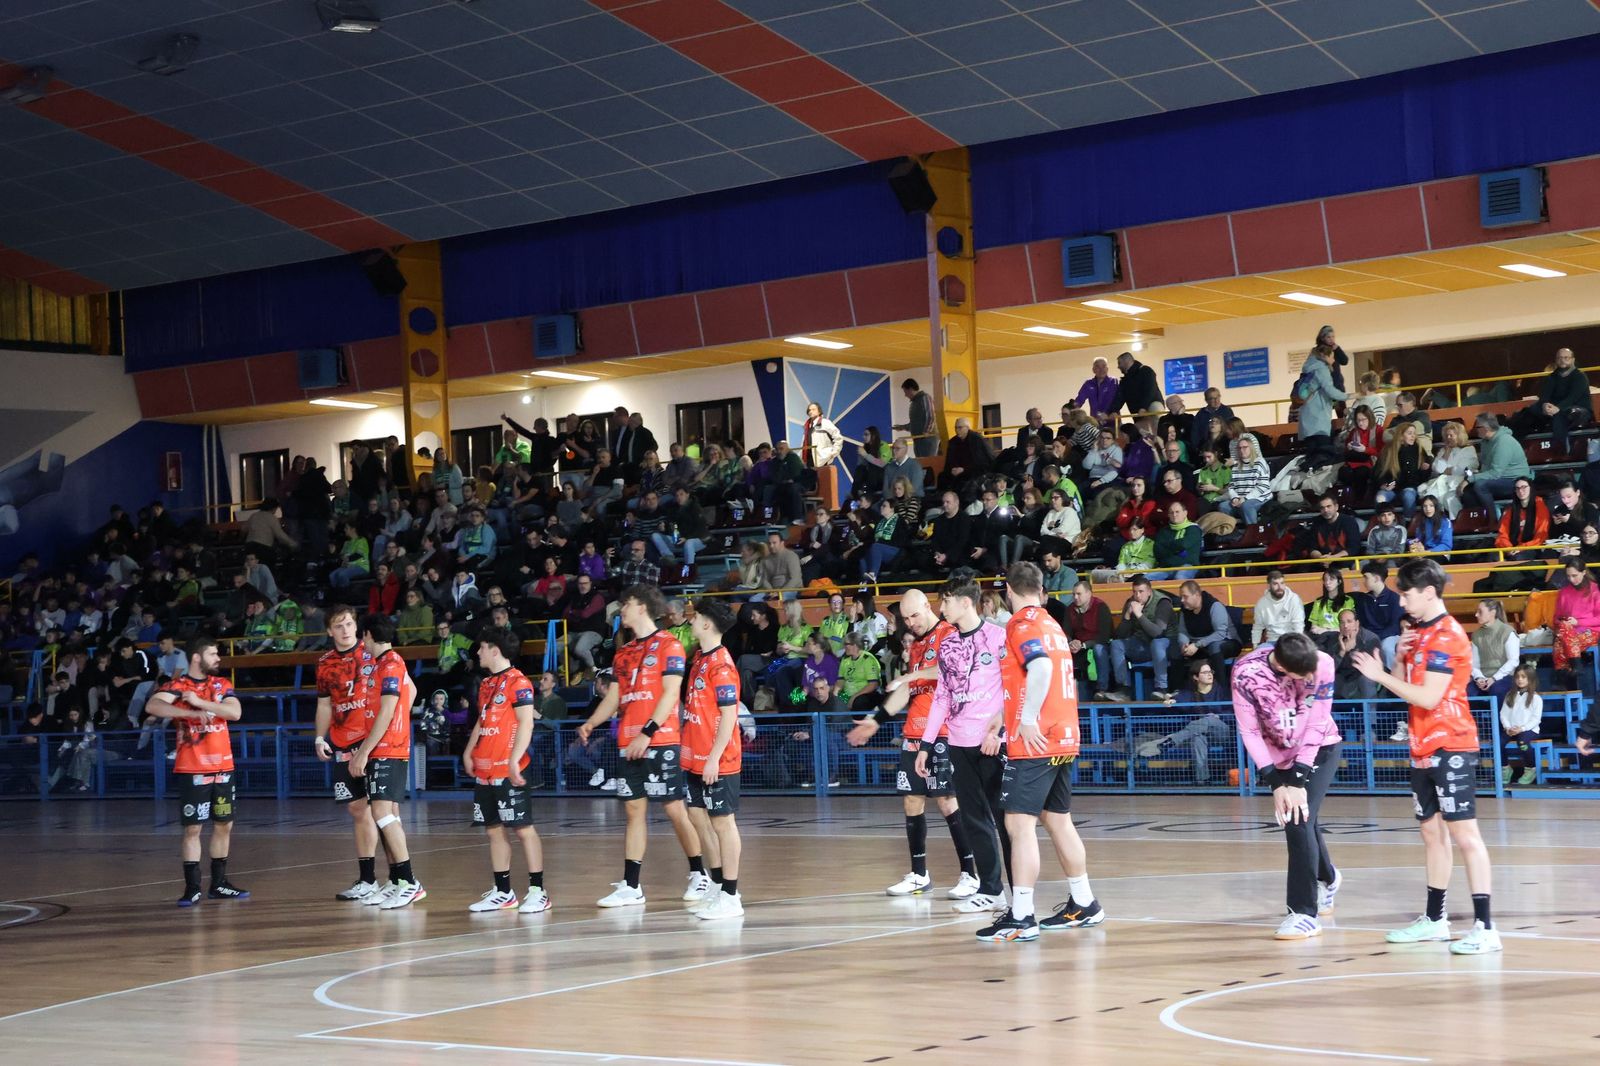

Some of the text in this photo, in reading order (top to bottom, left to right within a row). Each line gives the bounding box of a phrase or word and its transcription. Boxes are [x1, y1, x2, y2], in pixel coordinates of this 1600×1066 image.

[1541, 441, 1551, 449] 15
[346, 680, 355, 697] 2
[336, 698, 367, 713] ABANC
[683, 709, 702, 725] BANCA
[1279, 708, 1297, 729] 16
